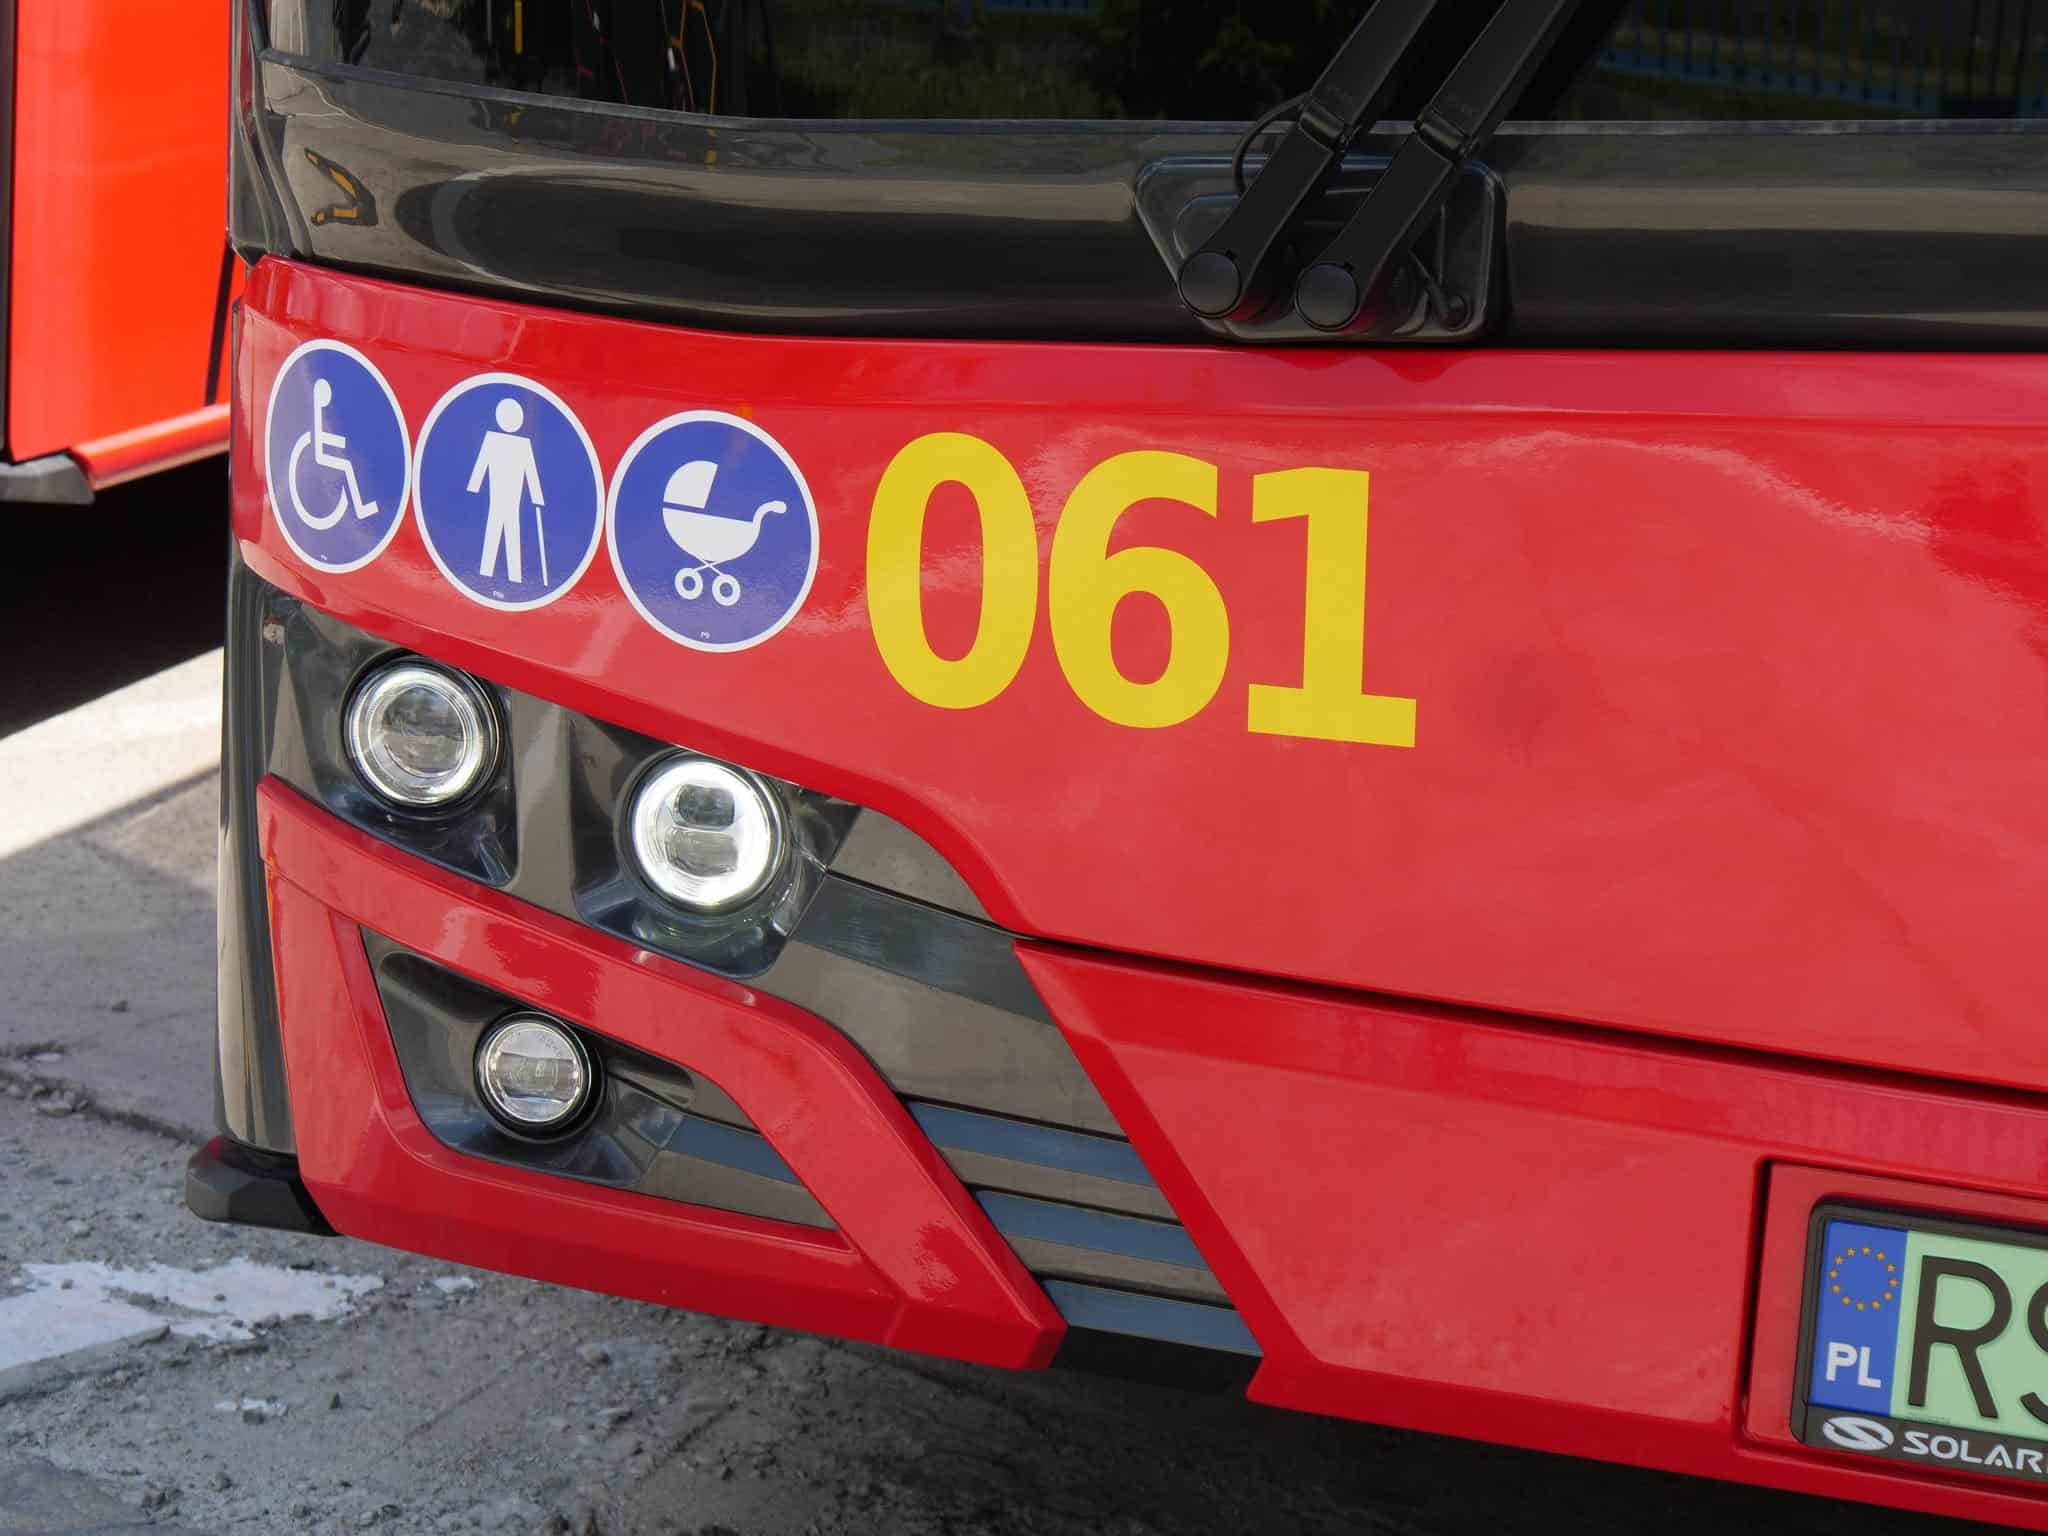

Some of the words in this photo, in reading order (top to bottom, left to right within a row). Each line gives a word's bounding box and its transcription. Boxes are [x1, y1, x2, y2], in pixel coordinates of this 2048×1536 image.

[866, 432, 1416, 747] 061
[1825, 1342, 1881, 1388] PL
[1902, 1431, 2048, 1473] SOLAR
